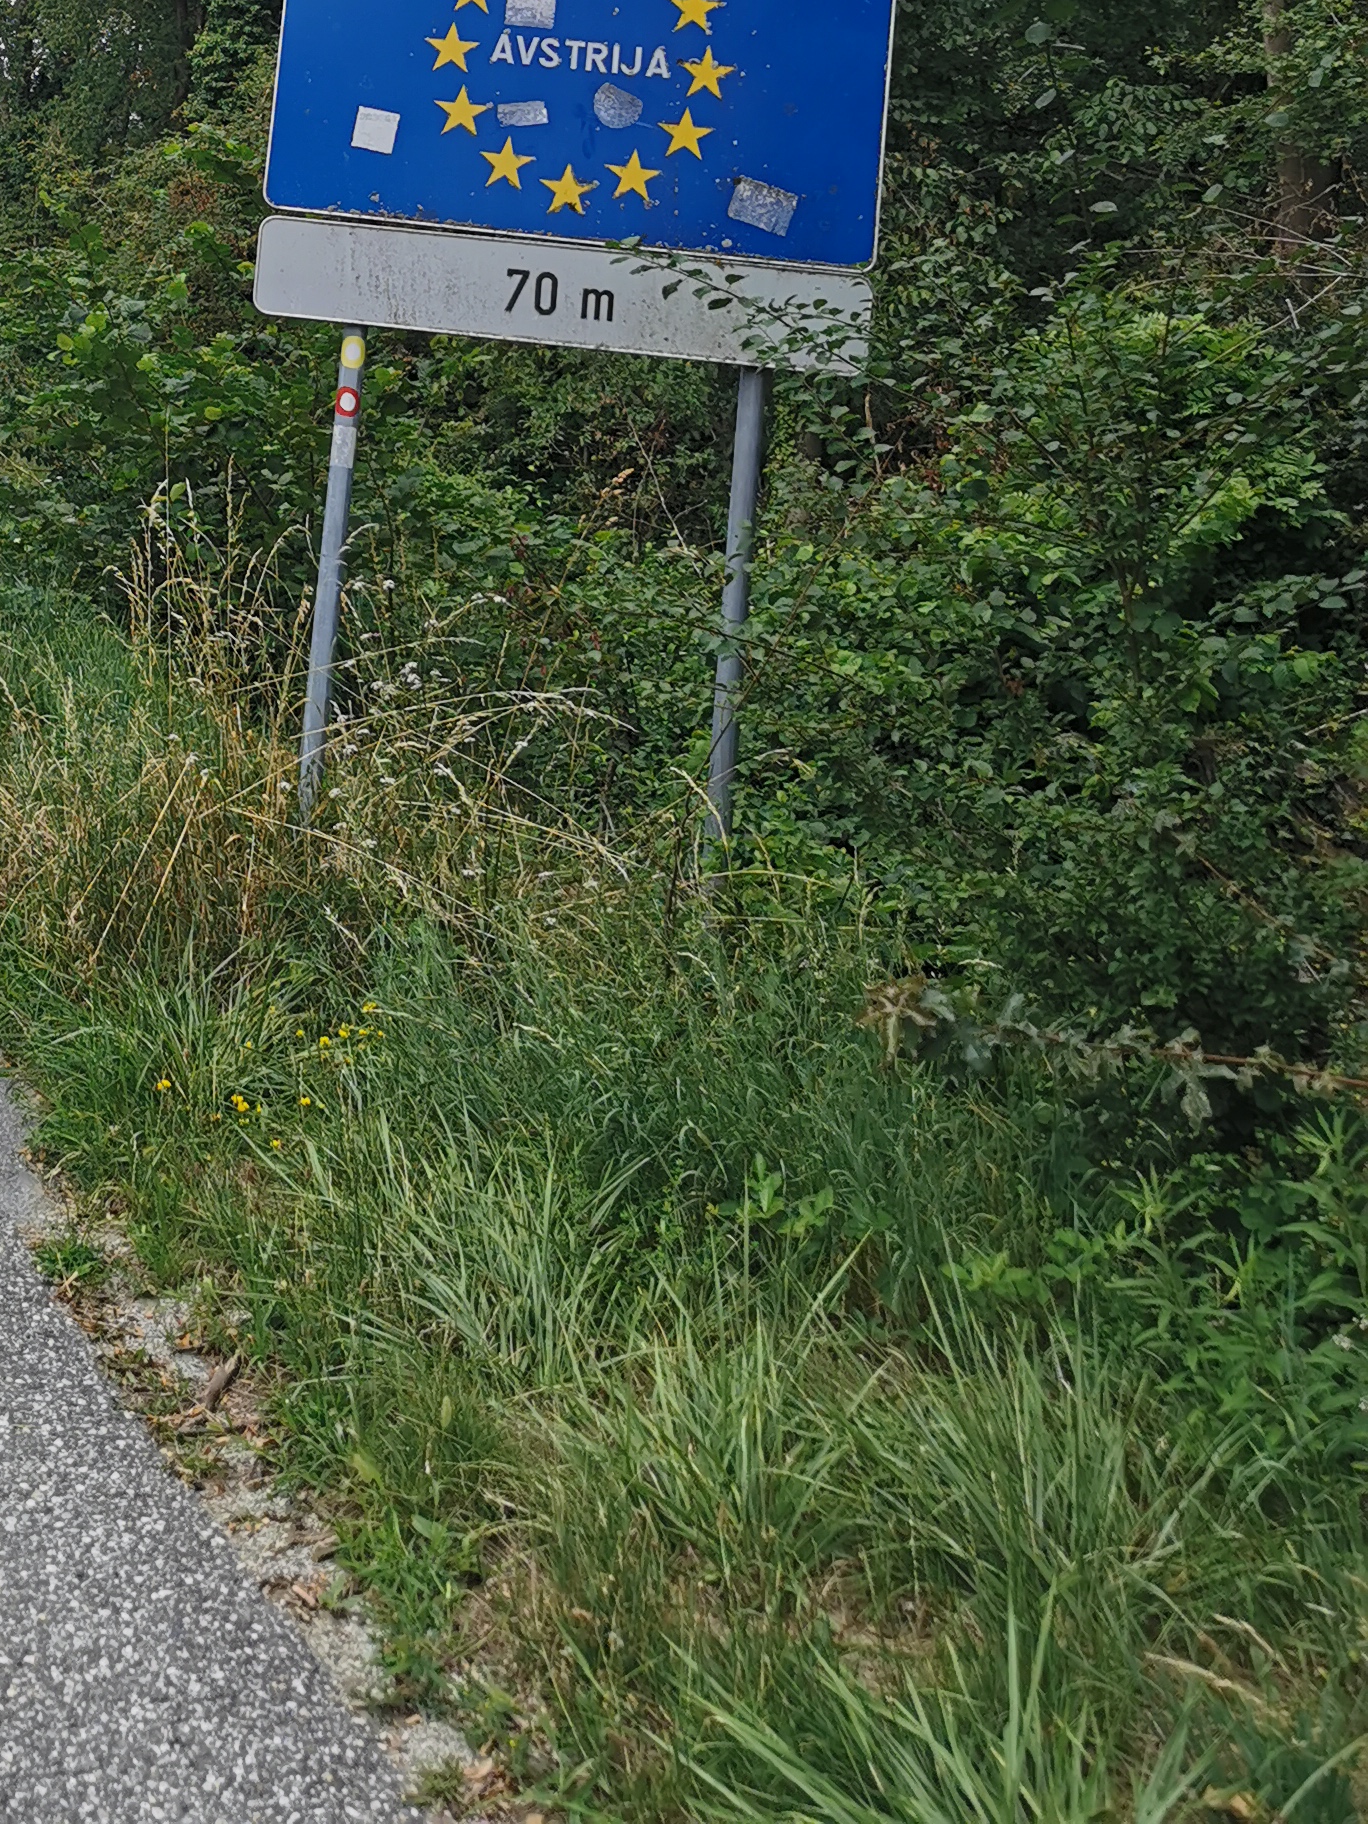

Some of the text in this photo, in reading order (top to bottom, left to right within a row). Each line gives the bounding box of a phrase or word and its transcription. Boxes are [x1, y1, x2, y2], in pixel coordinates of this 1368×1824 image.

[490, 29, 671, 78] AVSTRIJA
[504, 268, 614, 322] 70 m
